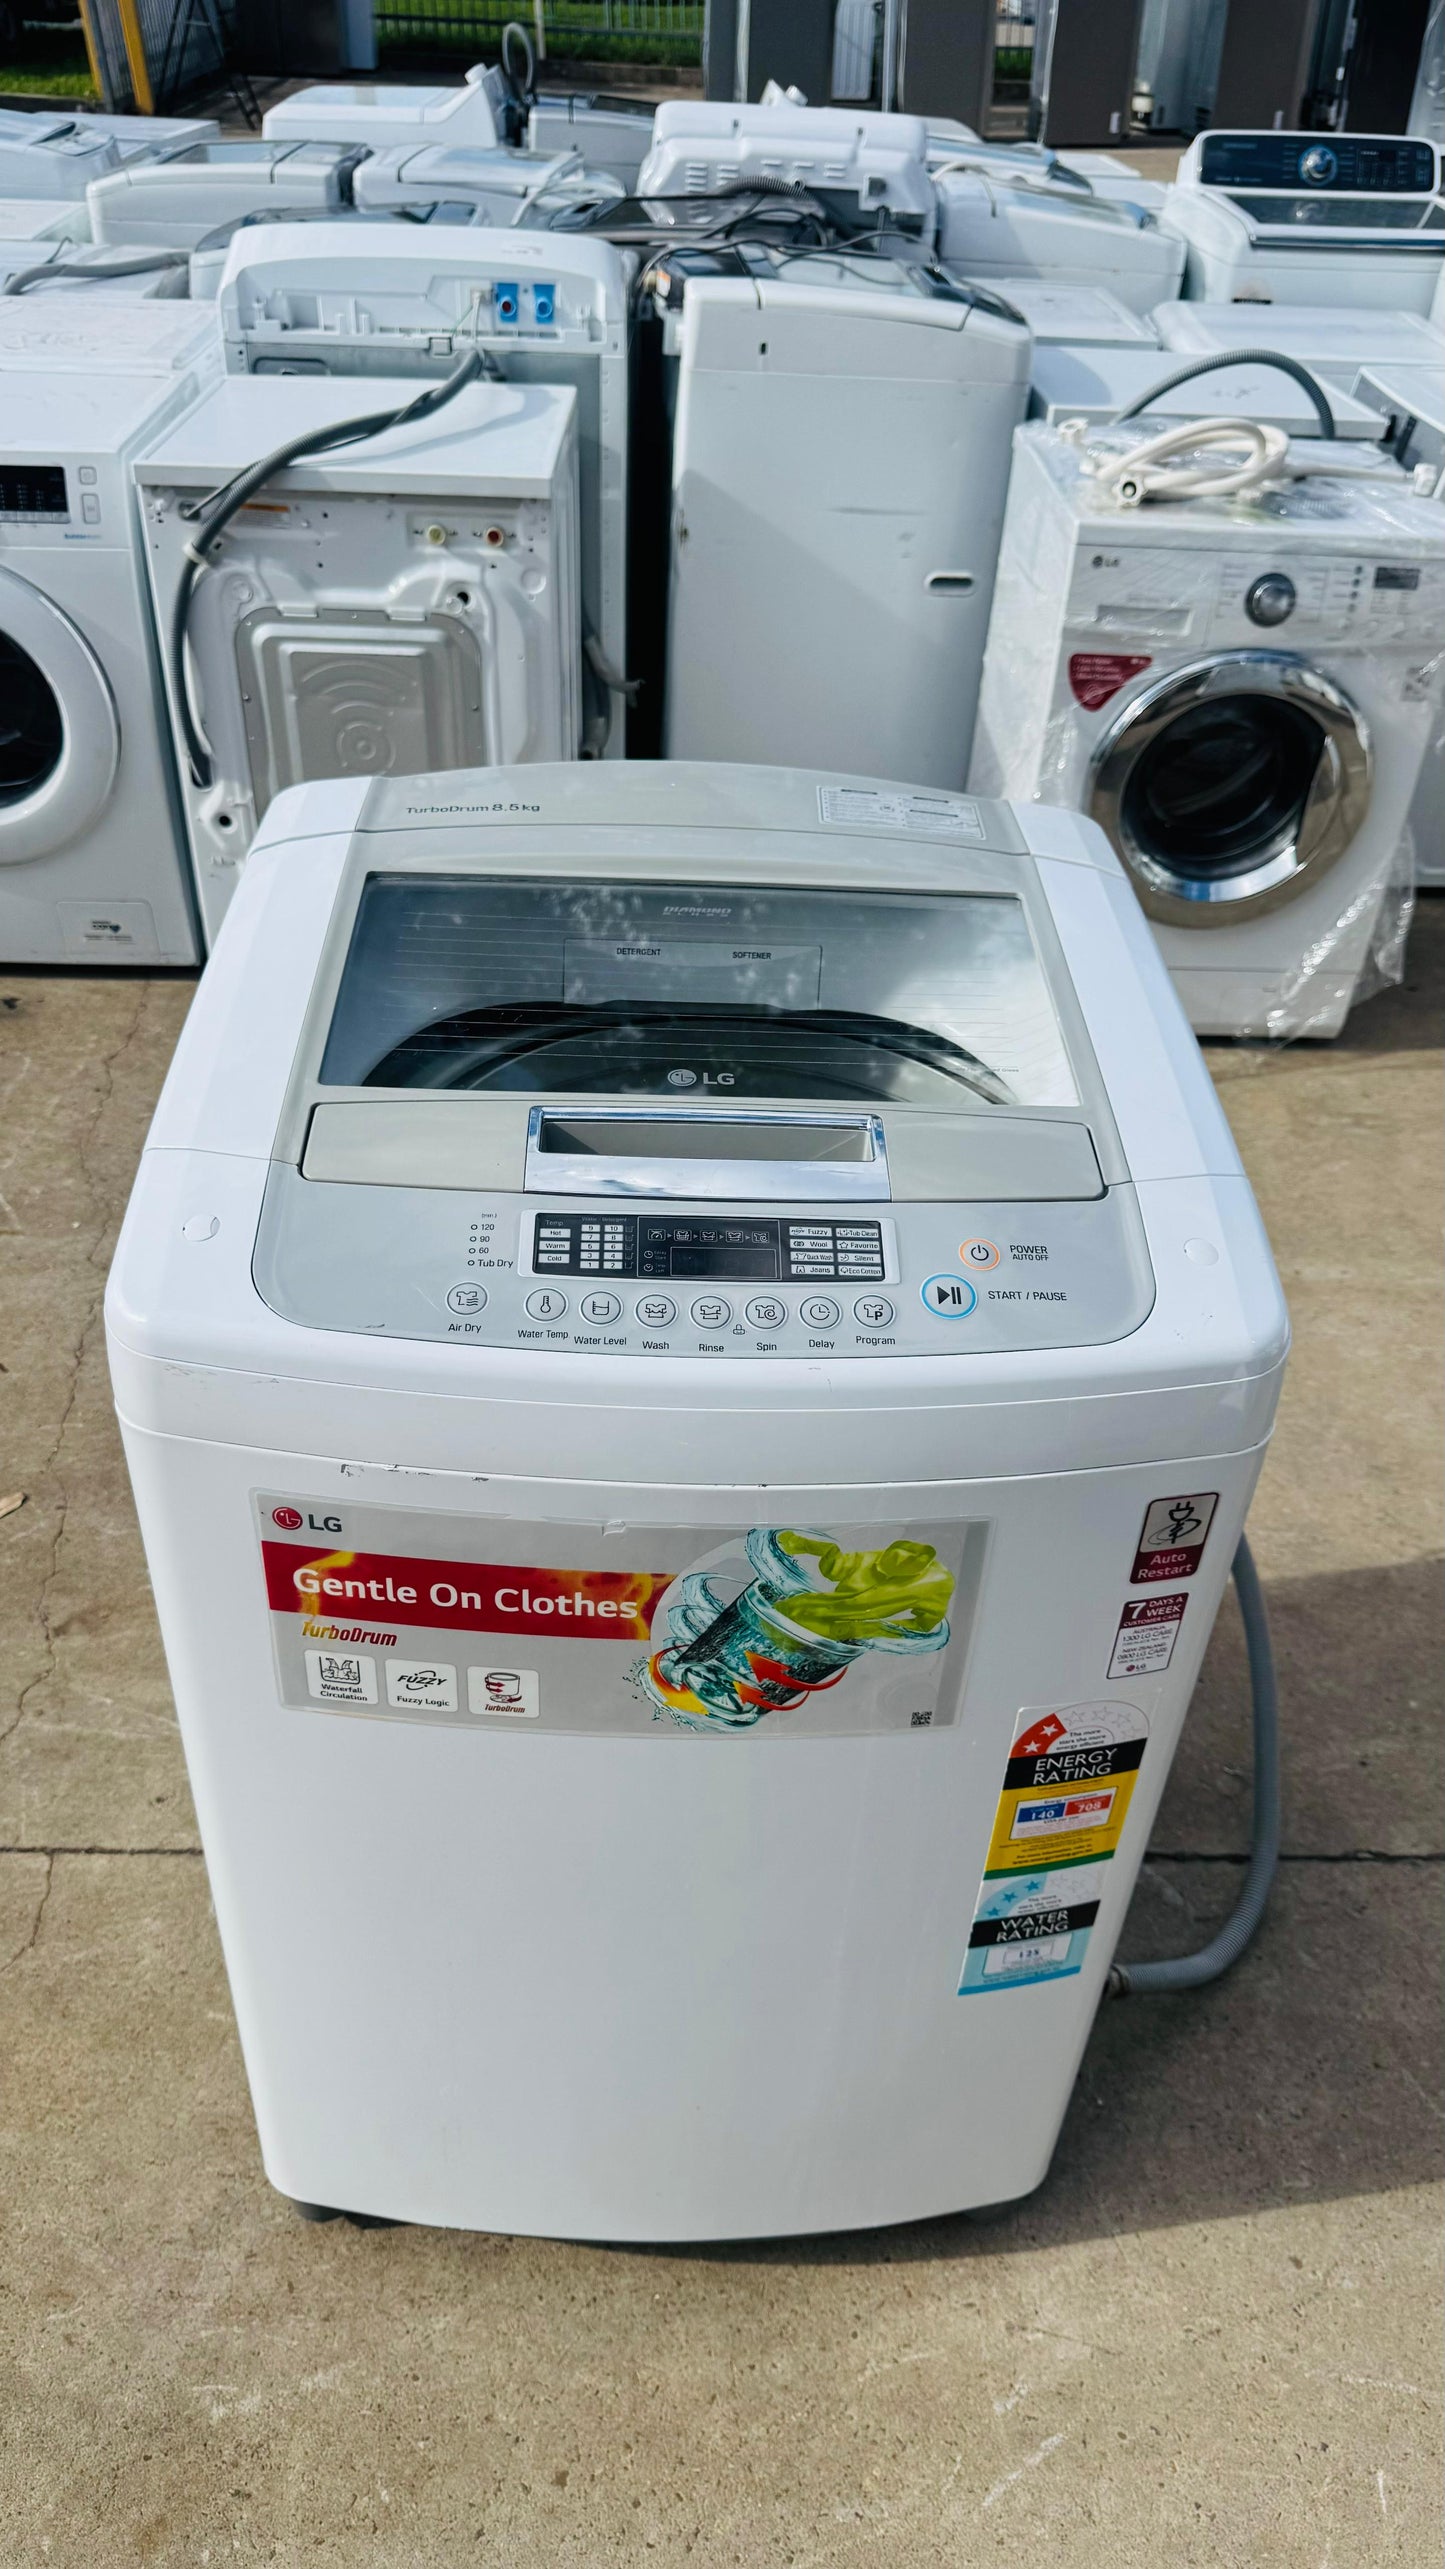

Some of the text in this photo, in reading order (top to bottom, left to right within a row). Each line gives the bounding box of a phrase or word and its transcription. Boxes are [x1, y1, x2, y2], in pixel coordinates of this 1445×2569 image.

[406, 803, 541, 814] TurboDrum 8.5 kg
[663, 906, 732, 914] DIAMOND
[616, 947, 661, 956] DETERGENT
[732, 951, 772, 960] SOFTENER
[703, 1072, 735, 1085] LG
[1010, 1245, 1048, 1255] POWER
[1012, 1253, 1033, 1261] AUTO
[477, 1259, 514, 1268] Tub Dry
[988, 1290, 1022, 1300] START
[1033, 1292, 1067, 1301] PAUSE
[448, 1323, 482, 1334] Air Dry
[517, 1329, 569, 1340] Water Temp
[574, 1336, 627, 1346] Water Level
[642, 1341, 670, 1350] Wash
[808, 1339, 835, 1350] Delay
[855, 1335, 896, 1346] Program
[699, 1343, 725, 1353] Rinse
[756, 1342, 777, 1352] Spin
[308, 1513, 343, 1533] LG
[1150, 1552, 1187, 1566] Auto
[1137, 1563, 1193, 1579] Restart
[292, 1567, 639, 1619] Gentle On Clothes
[1149, 1597, 1174, 1607] DAYS
[1129, 1602, 1147, 1619] 7
[1146, 1604, 1182, 1617] WEEK
[301, 1621, 398, 1647] TurboDrum
[397, 1674, 448, 1686] FUZZY
[321, 1683, 363, 1694] Waterfall
[320, 1690, 368, 1702] Circulation
[396, 1695, 450, 1707] Fuzzy Logic
[484, 1703, 526, 1714] TurboDrum
[1035, 1747, 1118, 1772] ENERGY
[1033, 1762, 1112, 1785] RATING
[1031, 1809, 1055, 1820] 140
[1001, 1910, 1069, 1930] WATER
[996, 1920, 1068, 1943] RATING
